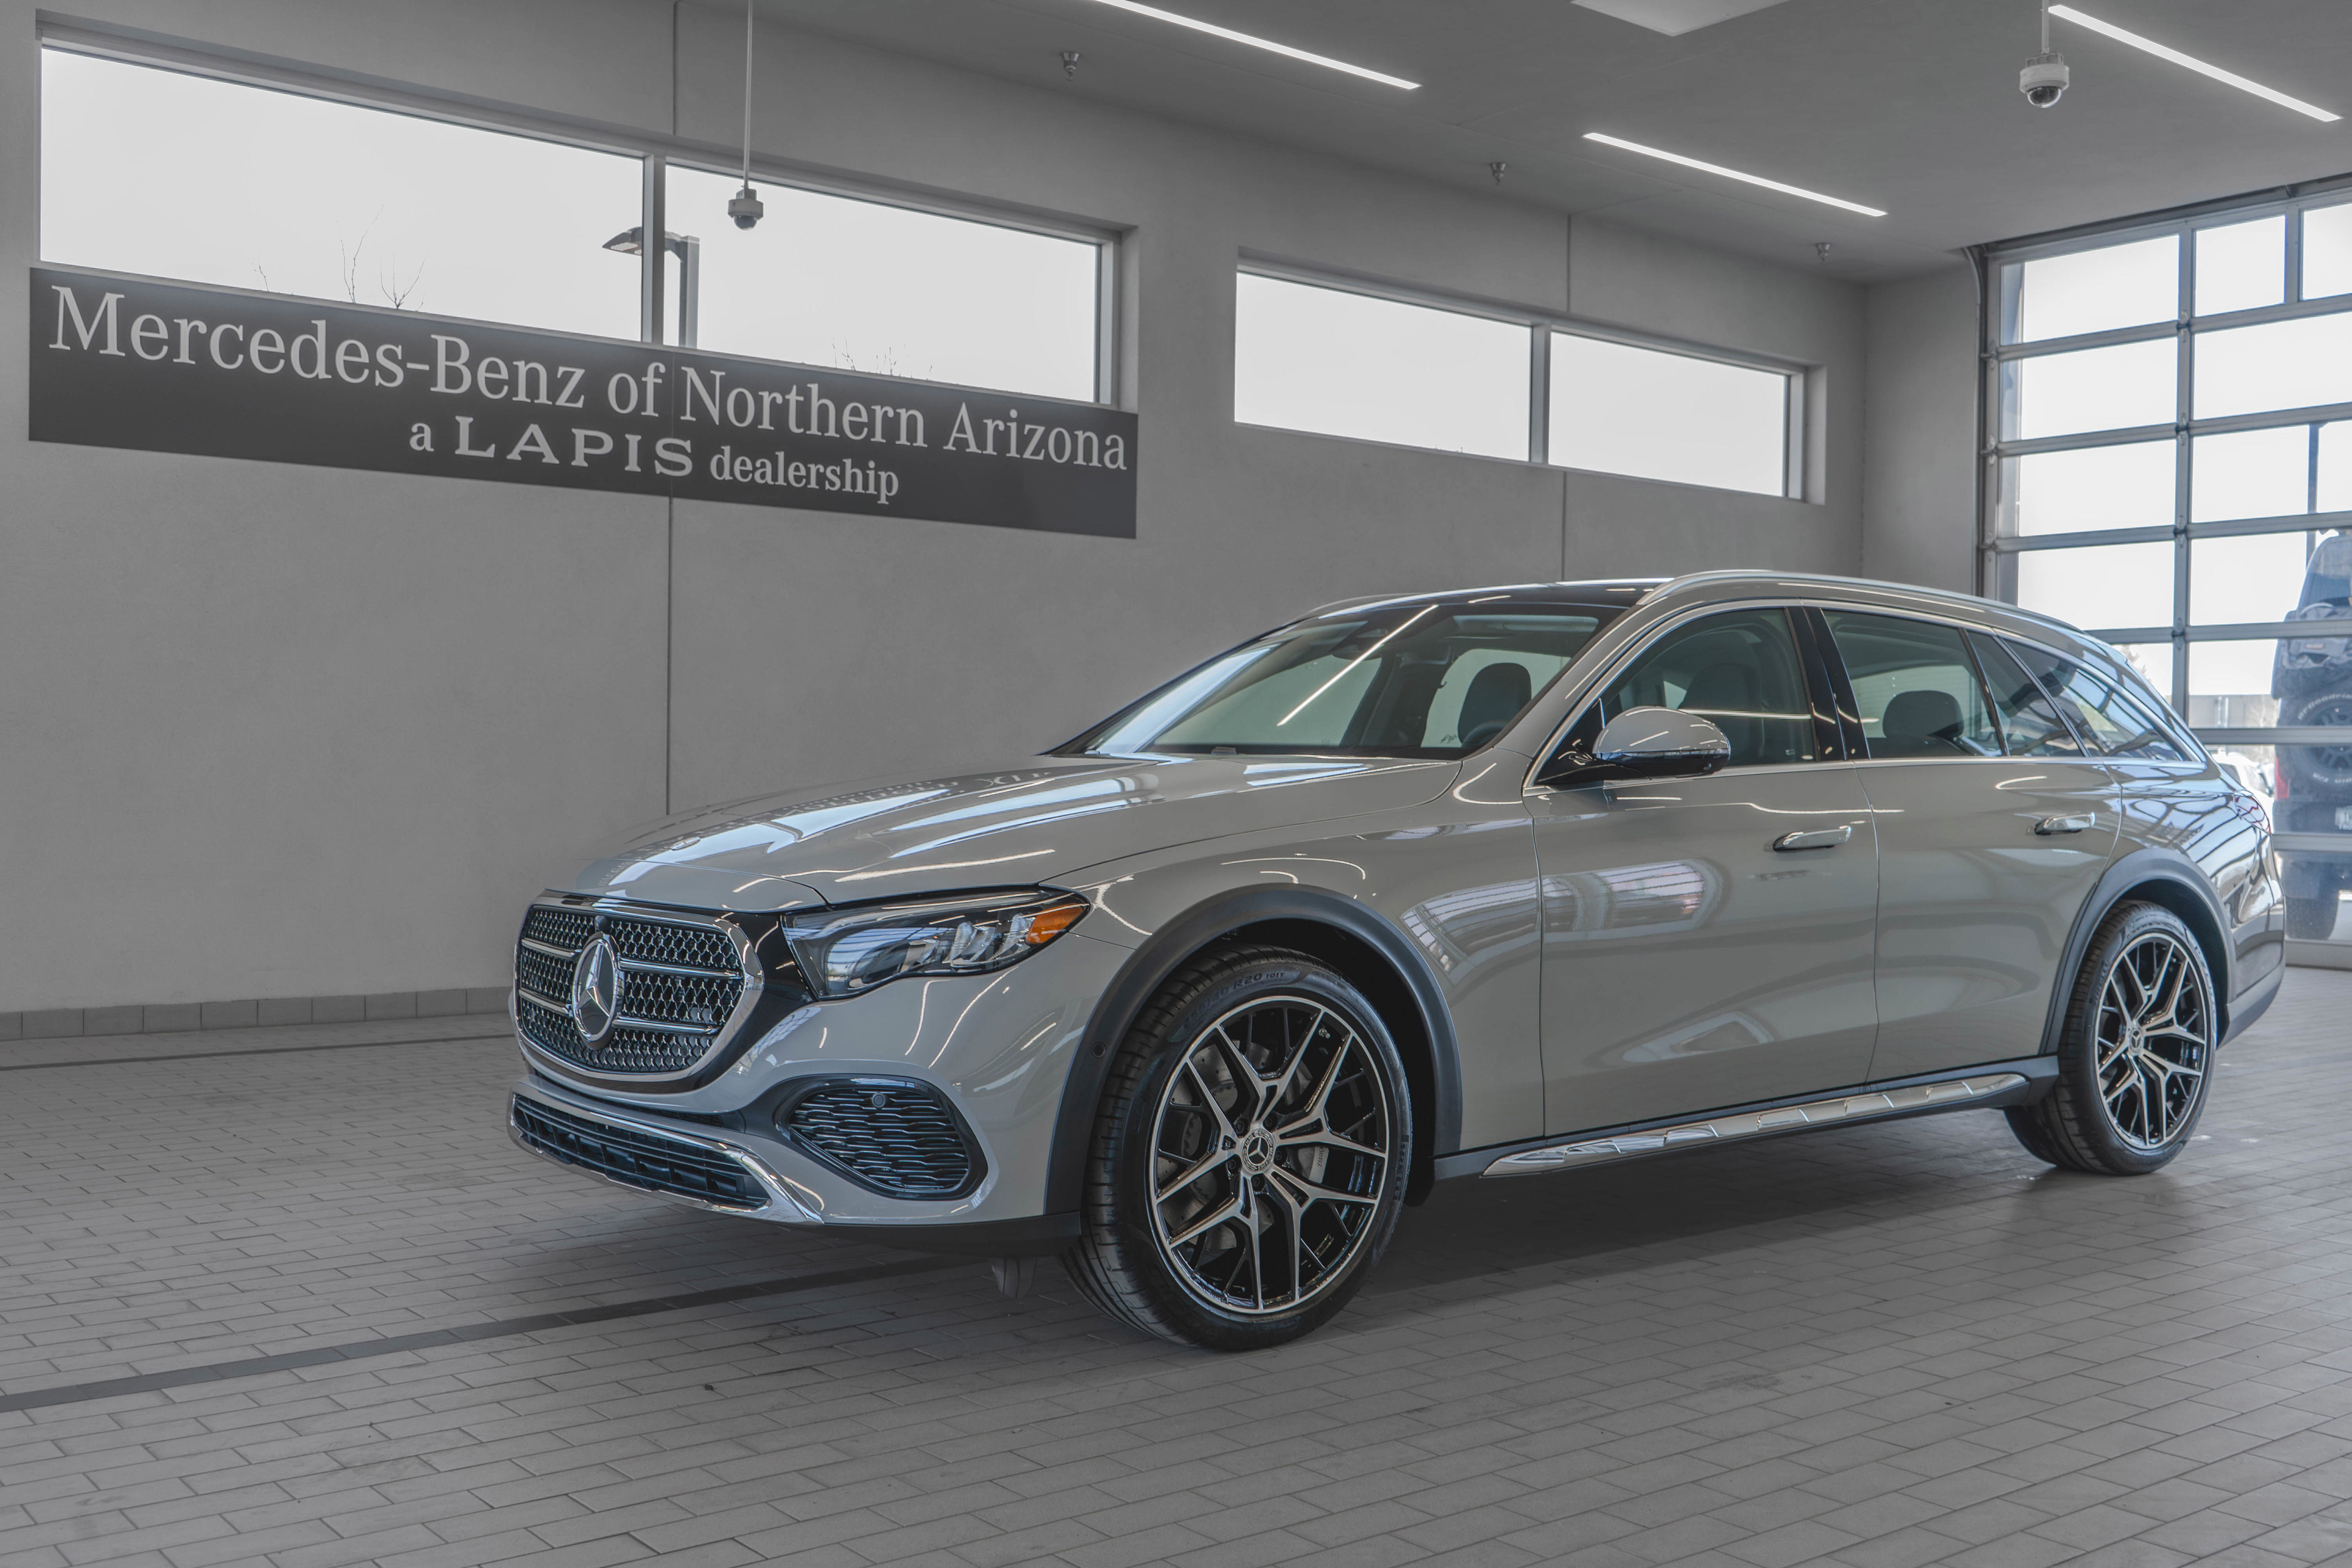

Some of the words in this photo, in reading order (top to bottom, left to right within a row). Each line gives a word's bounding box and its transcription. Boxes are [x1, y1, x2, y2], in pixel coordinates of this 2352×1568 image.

[49, 285, 585, 408] Mercedes-Benz
[608, 362, 666, 416] of
[680, 366, 927, 447] Northern
[943, 402, 1127, 470] Arizona
[410, 423, 434, 451] a
[455, 416, 692, 476] LAPIS
[710, 446, 898, 504] dealership
[1234, 973, 1262, 989] R20
